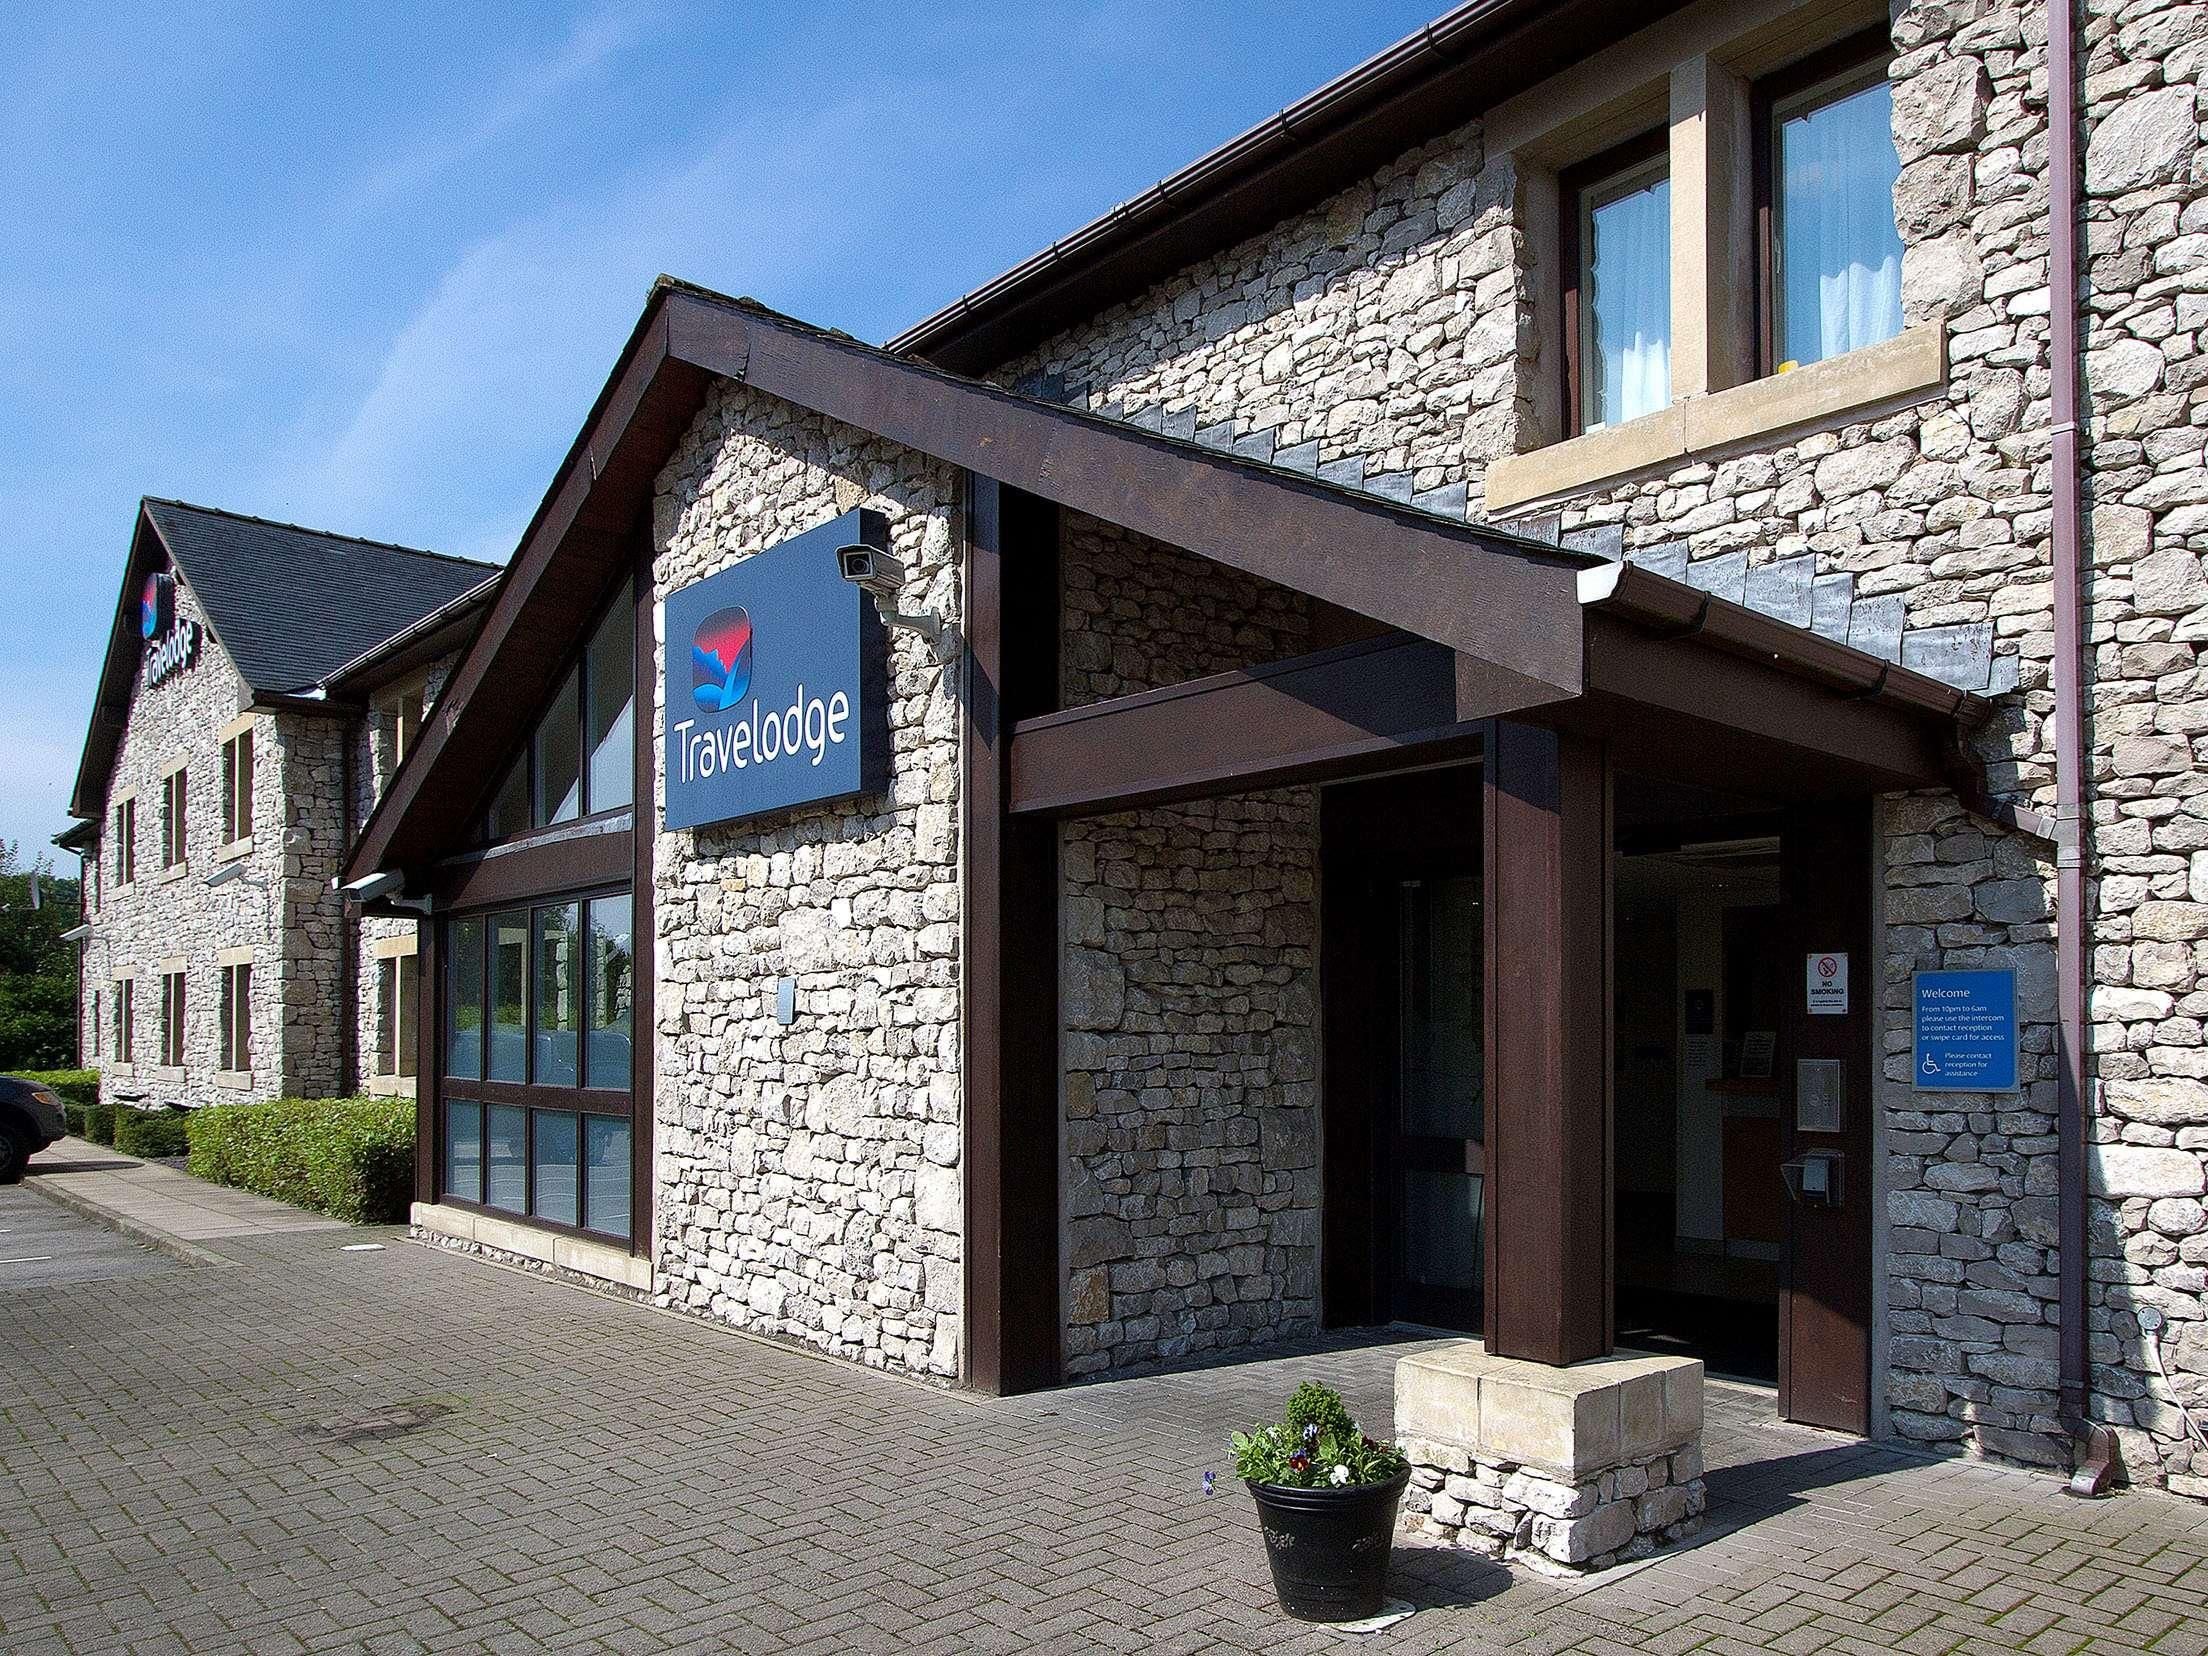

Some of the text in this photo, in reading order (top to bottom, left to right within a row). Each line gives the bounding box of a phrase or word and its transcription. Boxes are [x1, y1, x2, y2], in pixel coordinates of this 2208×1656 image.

[146, 616, 193, 688] Travelodge
[673, 683, 850, 784] Travelodge
[1921, 988, 1970, 998] Welcome
[1942, 1005, 1961, 1014] 10pm
[1921, 1015, 1944, 1023] please
[1957, 1024, 1993, 1033] reception
[1930, 1034, 1950, 1042] swipe
[1944, 1061, 1977, 1069] reception
